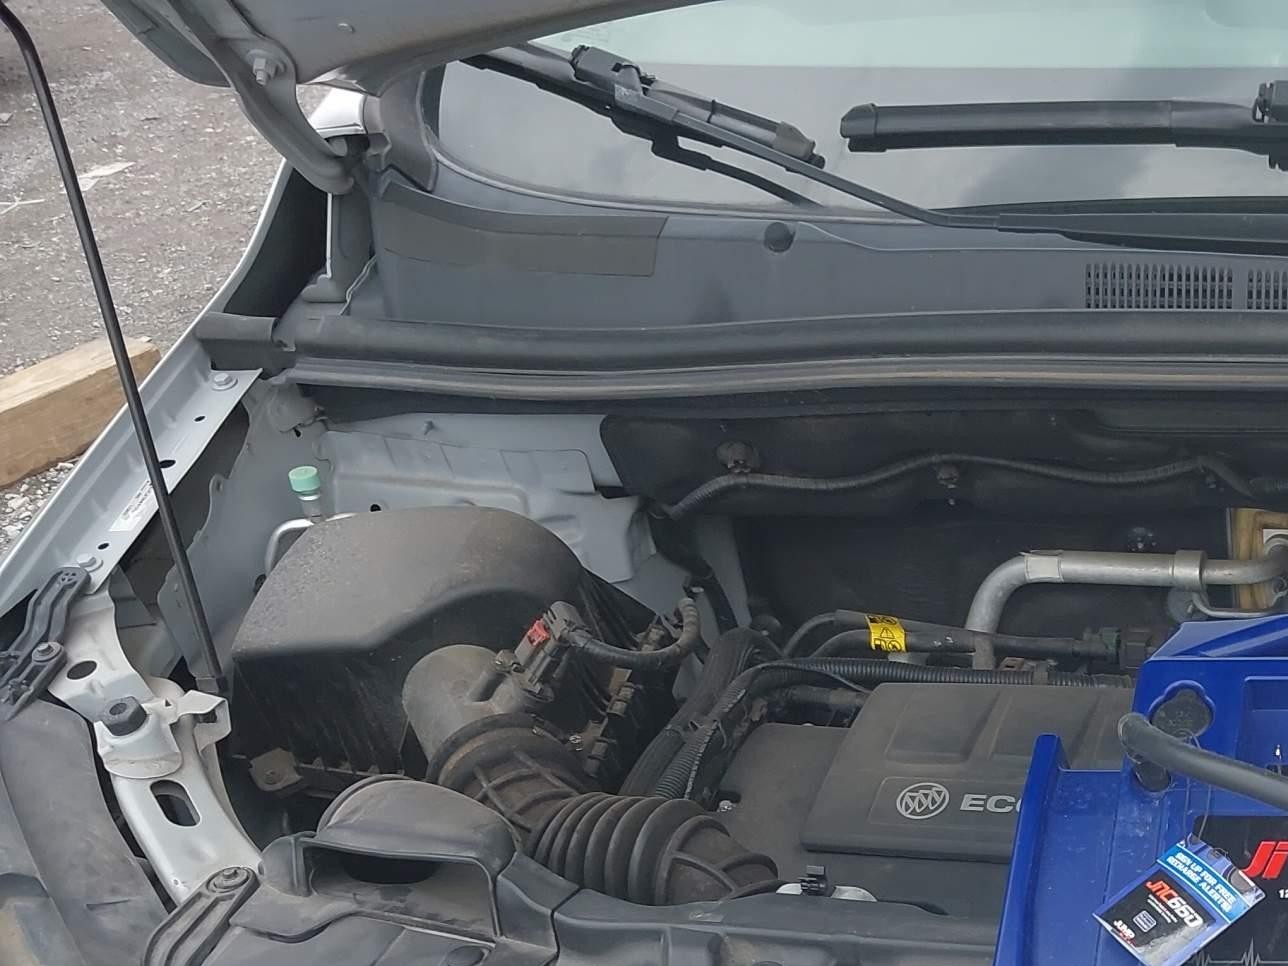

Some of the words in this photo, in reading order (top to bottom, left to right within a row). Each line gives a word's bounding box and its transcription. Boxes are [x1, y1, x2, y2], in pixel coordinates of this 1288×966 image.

[959, 793, 1023, 814] EC
[1189, 862, 1203, 875] UP
[1199, 870, 1218, 887] FOR
[1213, 882, 1238, 905] FREE
[1146, 880, 1204, 928] JNC660
[1114, 920, 1136, 939] JUMP
